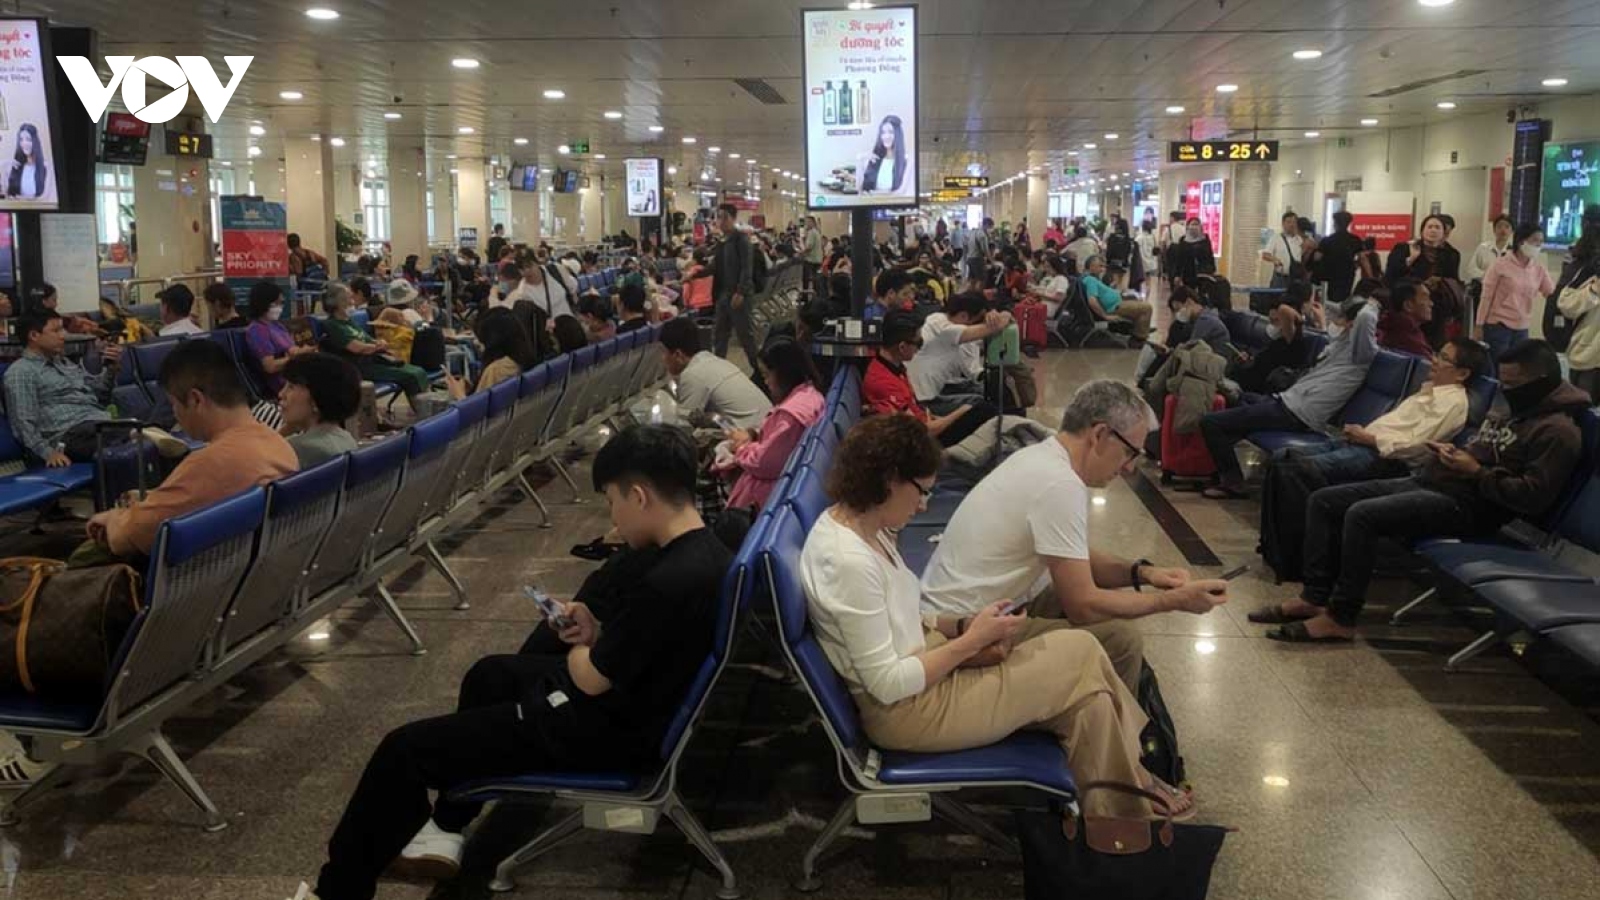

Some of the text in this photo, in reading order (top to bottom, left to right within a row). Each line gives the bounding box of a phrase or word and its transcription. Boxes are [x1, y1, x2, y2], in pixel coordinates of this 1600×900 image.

[840, 36, 905, 51] dưỡng tóc
[192, 137, 200, 154] 7
[1201, 144, 1213, 159] 8
[1230, 144, 1251, 159] 25
[226, 252, 252, 260] SKY
[226, 260, 281, 270] PRIORITY
